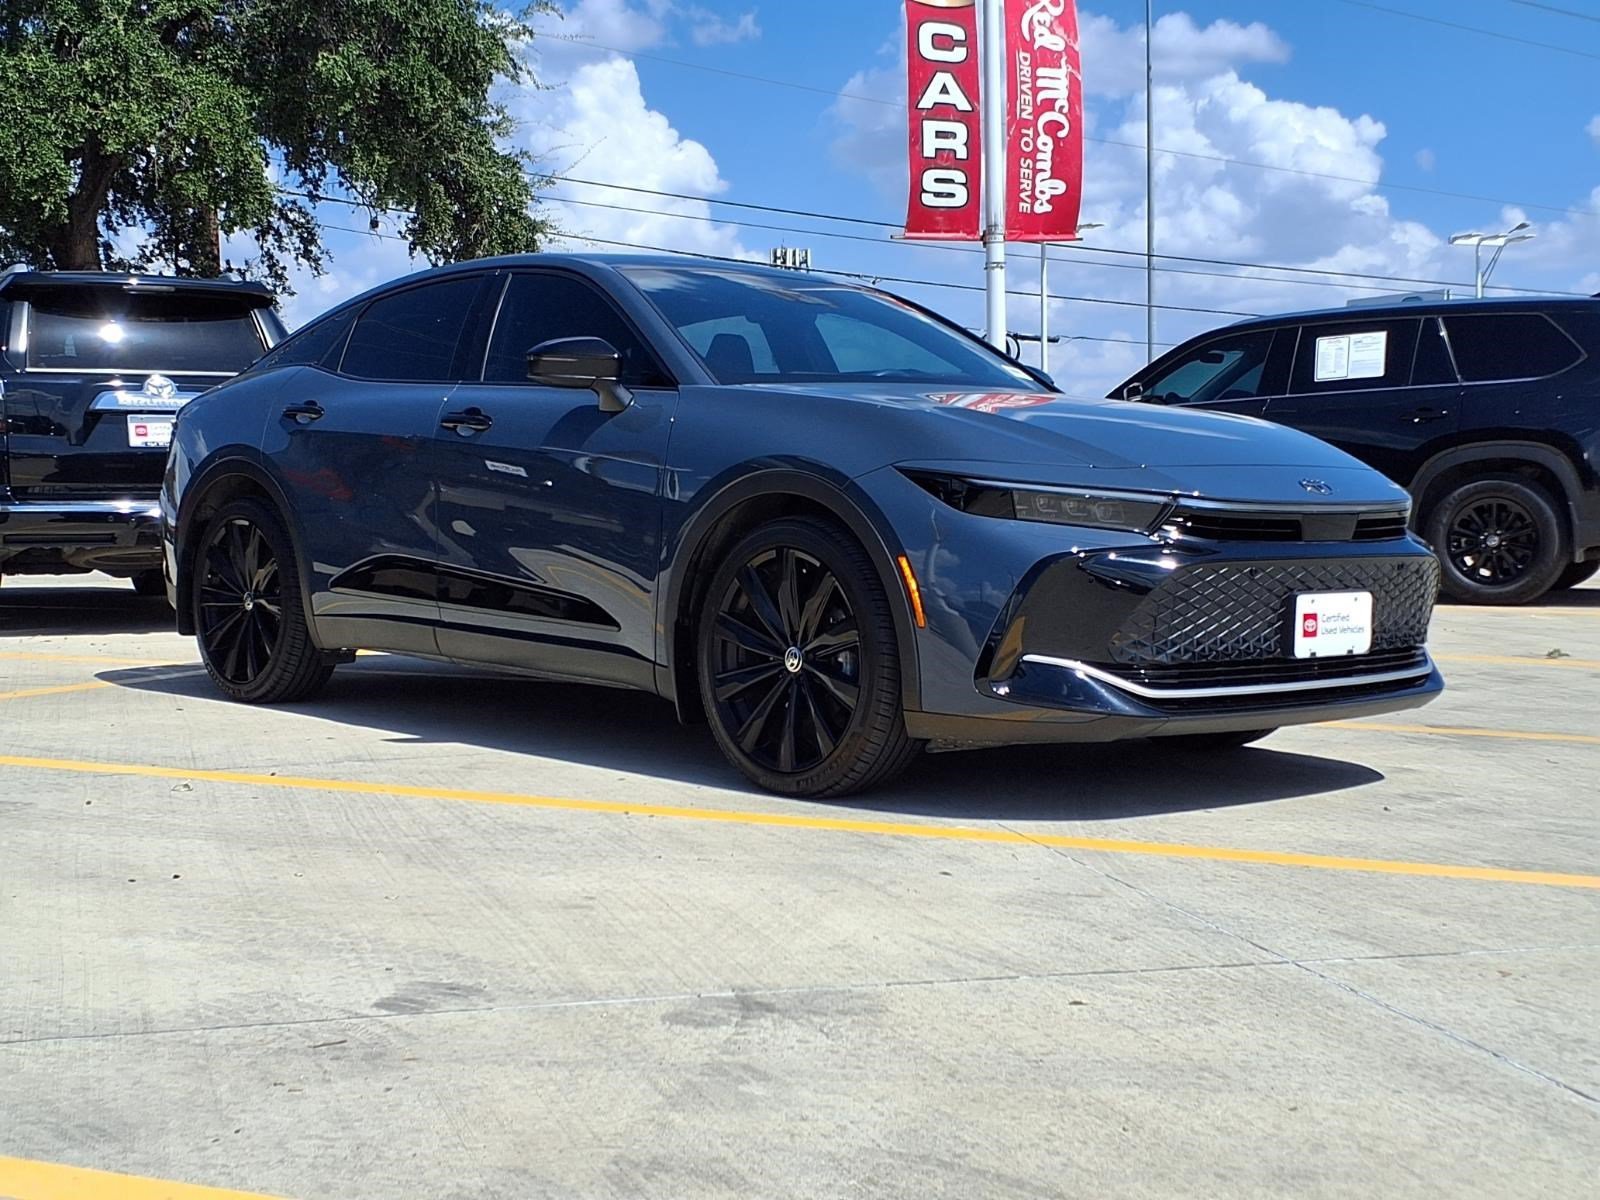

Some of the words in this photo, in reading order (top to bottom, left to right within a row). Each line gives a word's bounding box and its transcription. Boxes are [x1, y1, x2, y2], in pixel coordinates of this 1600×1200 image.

[1021, 0, 1066, 51] Red
[916, 20, 973, 208] CARS
[1019, 51, 1034, 120] DRIVEN
[1020, 127, 1034, 153] TO
[1019, 157, 1034, 214] SERVE
